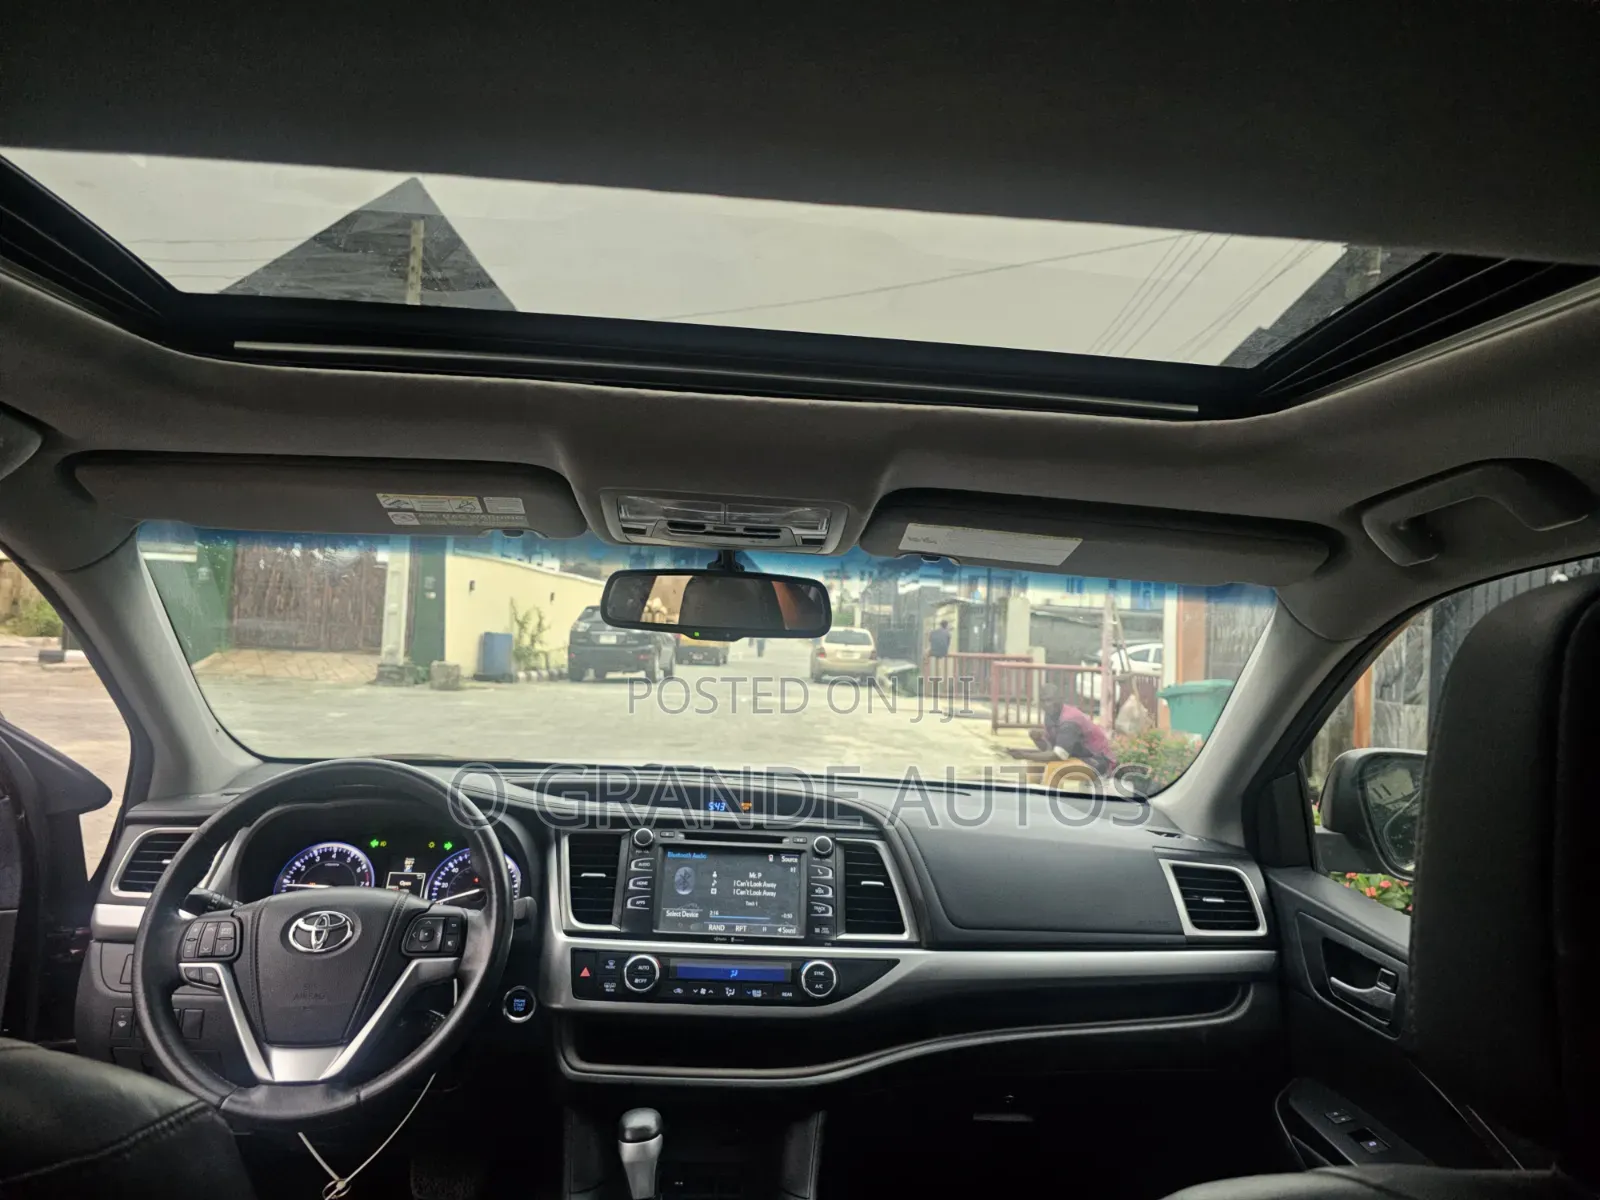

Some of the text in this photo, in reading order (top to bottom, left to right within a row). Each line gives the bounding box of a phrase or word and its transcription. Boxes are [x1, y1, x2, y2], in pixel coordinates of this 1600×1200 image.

[781, 855, 798, 863] Source
[737, 880, 750, 888] Can't
[736, 888, 750, 896] Can't
[666, 910, 681, 918] Select
